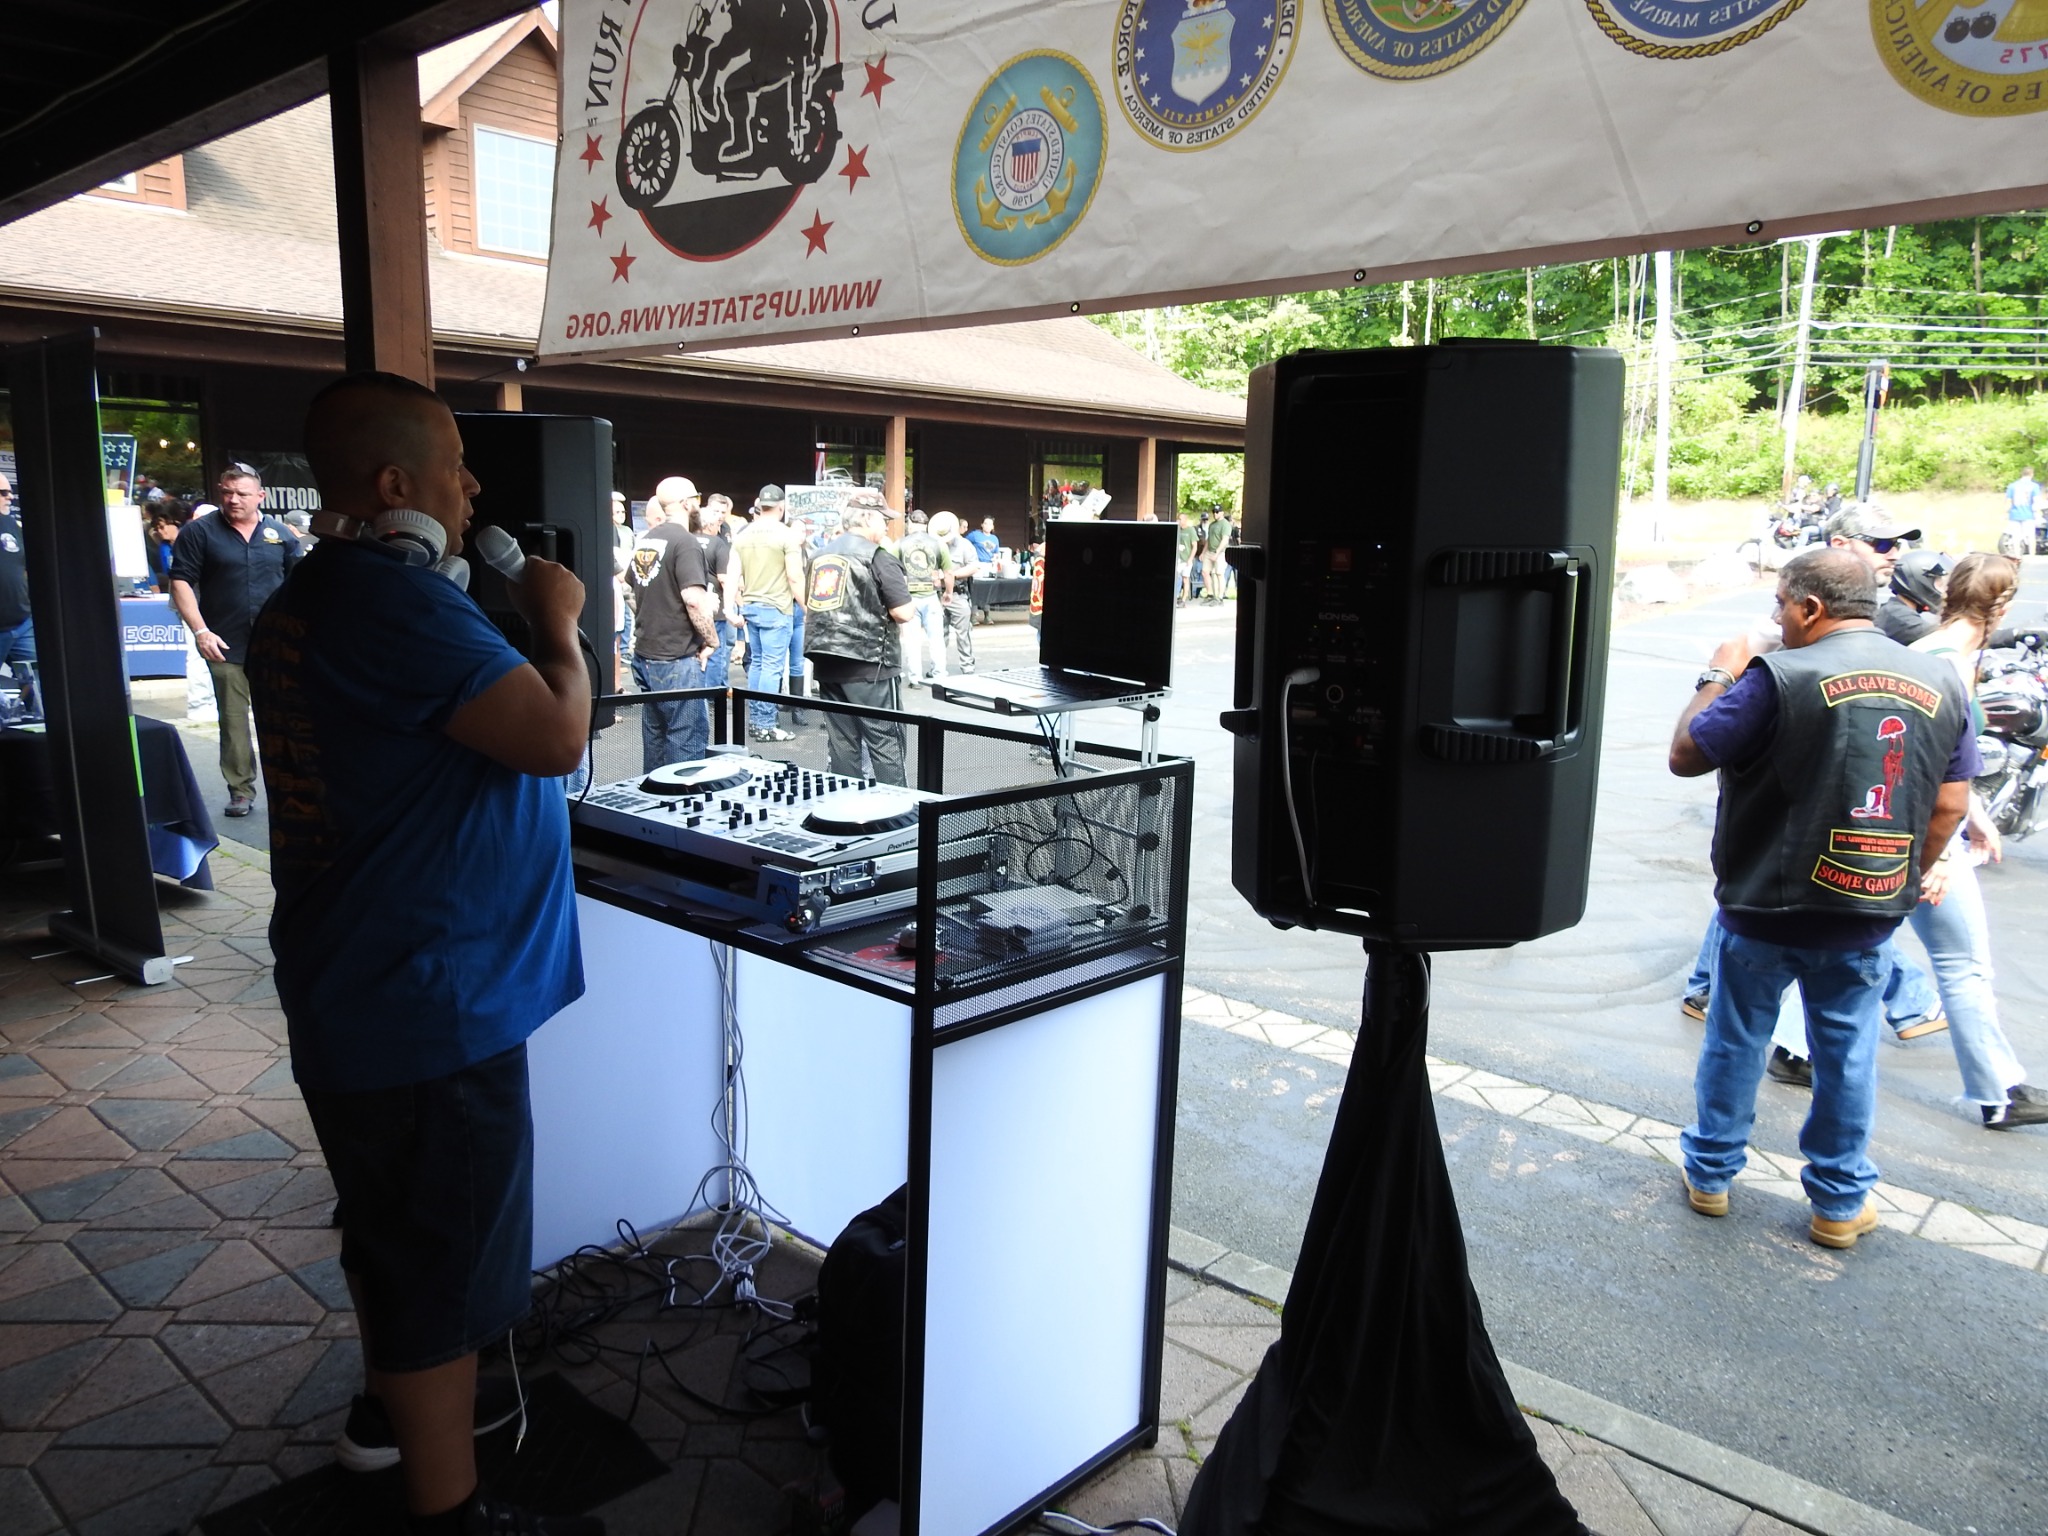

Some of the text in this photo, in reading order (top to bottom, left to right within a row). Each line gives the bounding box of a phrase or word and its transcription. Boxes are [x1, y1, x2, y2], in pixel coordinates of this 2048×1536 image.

[1827, 676, 1938, 708] ALL GAVE SOME
[887, 837, 918, 852] Pioneer
[1818, 865, 1863, 890] SOME
[1865, 876, 1896, 895] GAVE
